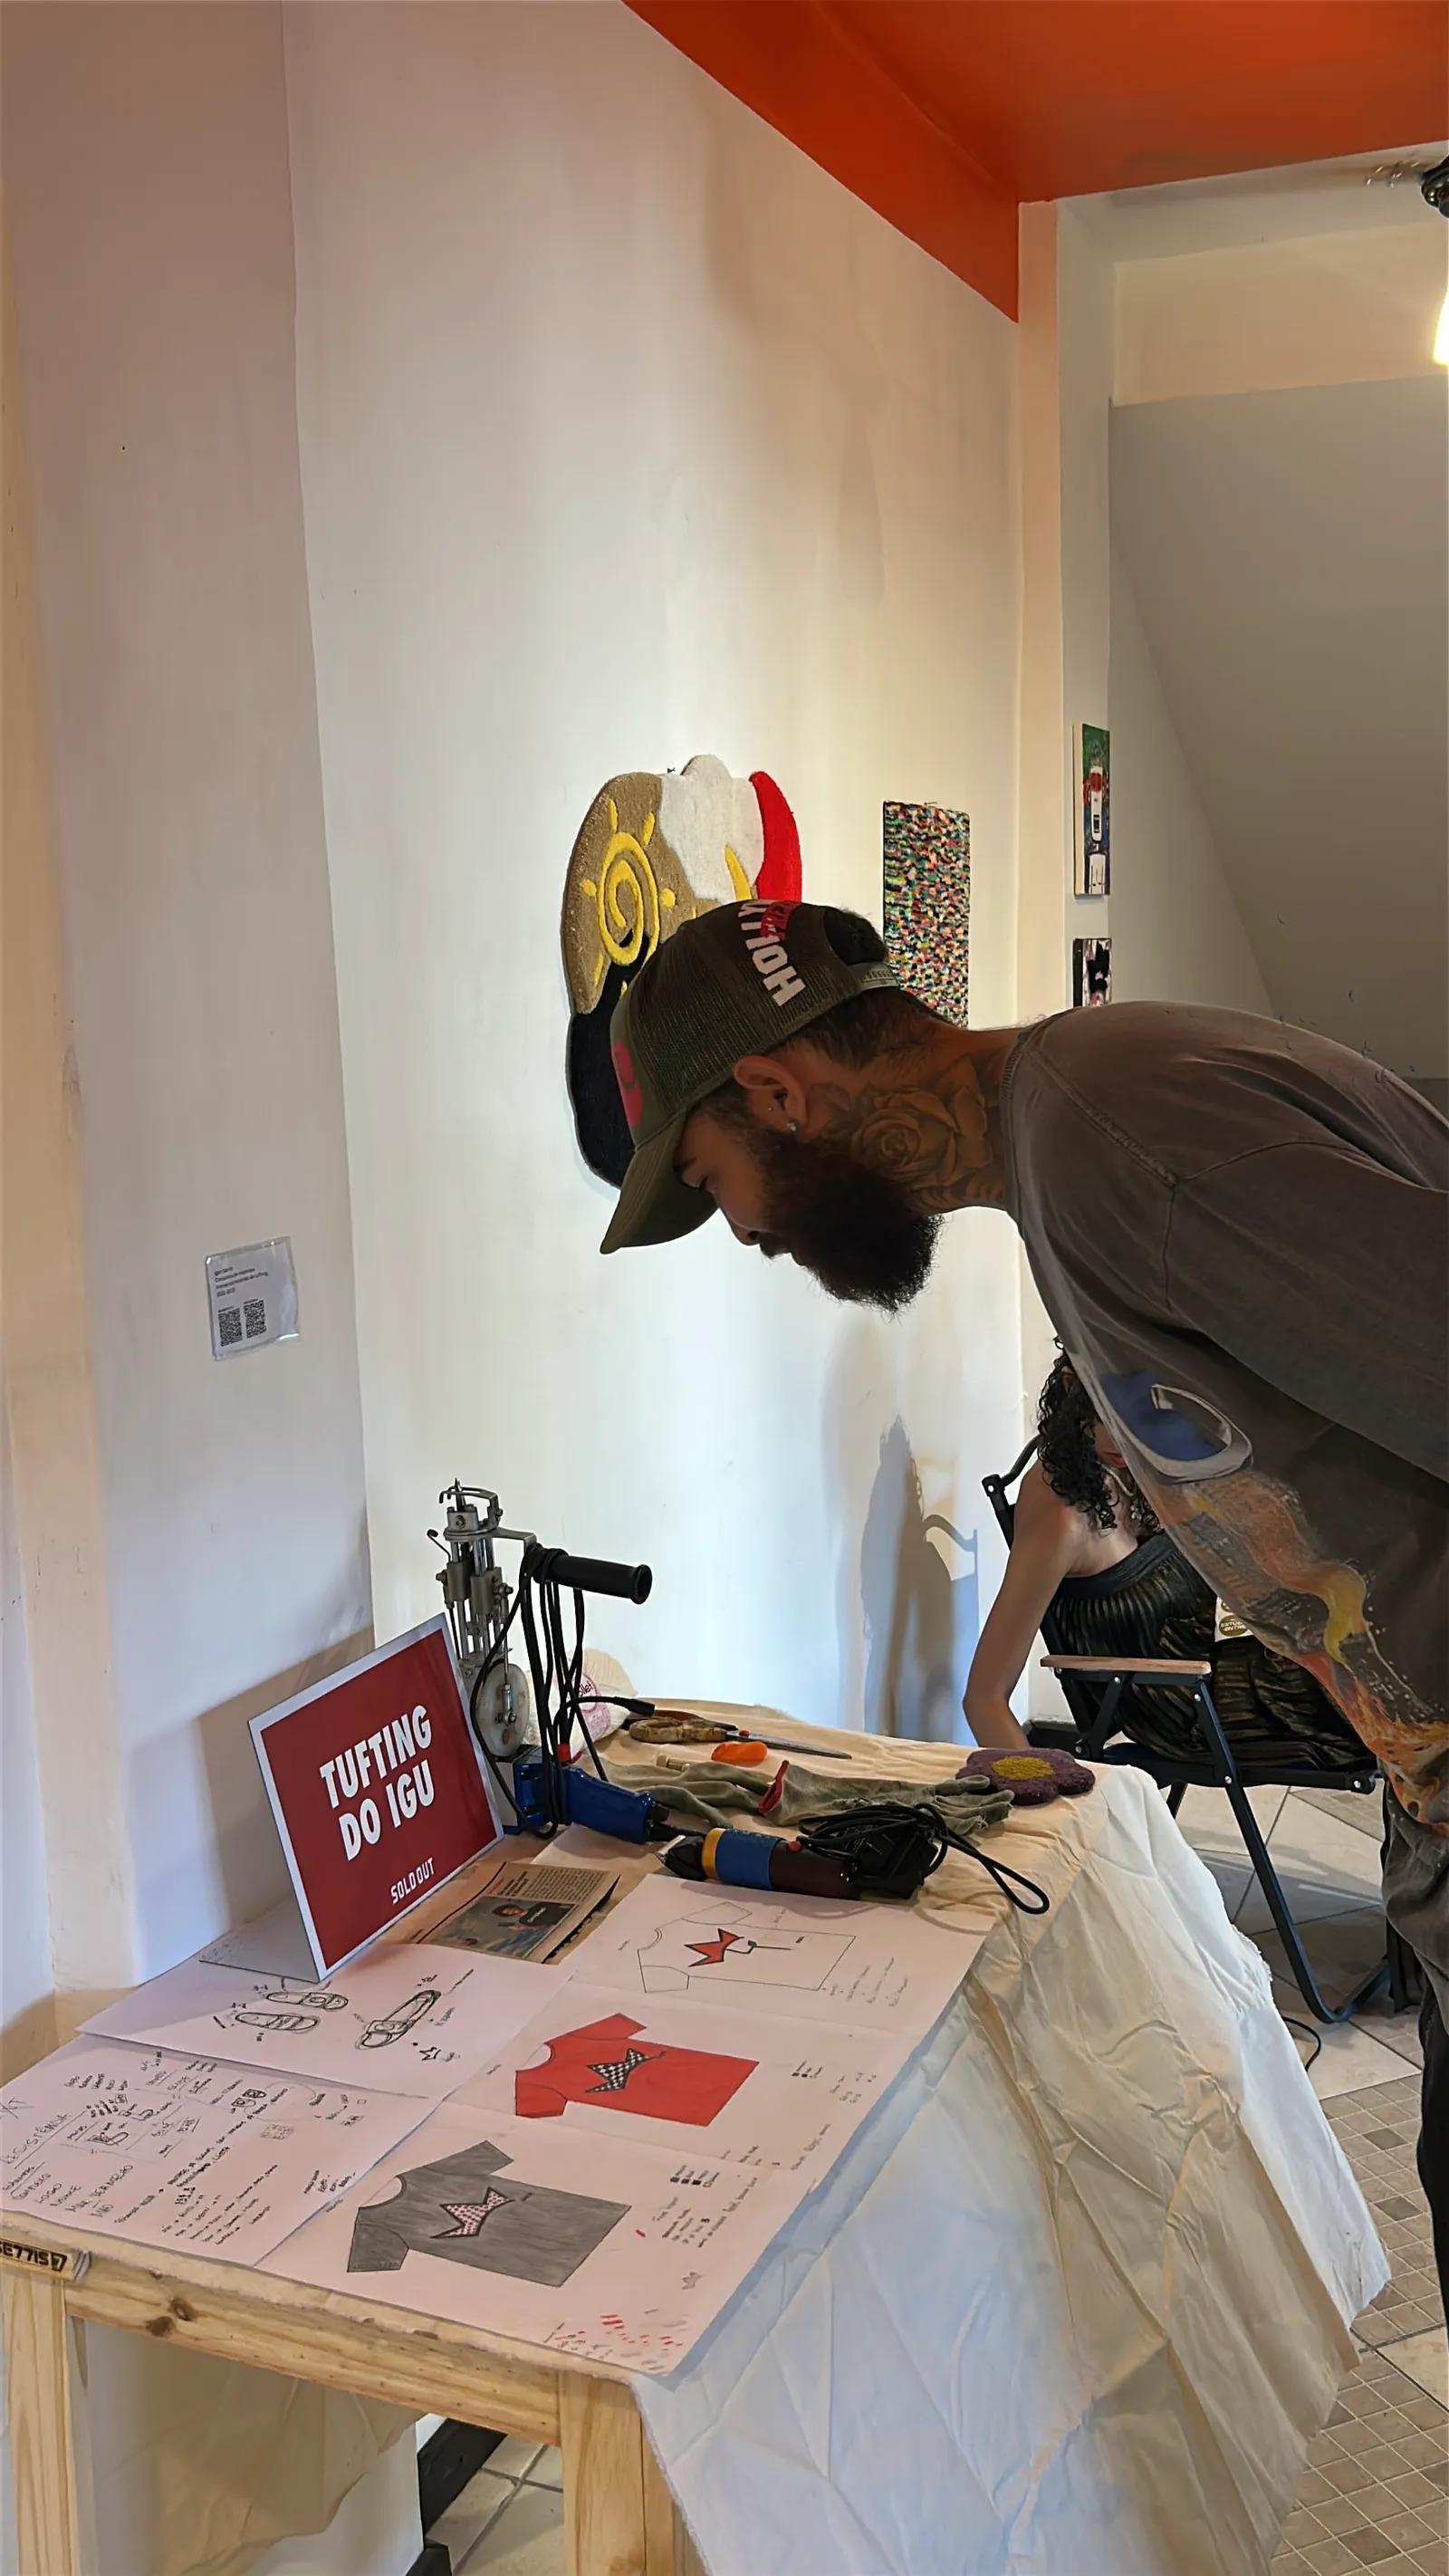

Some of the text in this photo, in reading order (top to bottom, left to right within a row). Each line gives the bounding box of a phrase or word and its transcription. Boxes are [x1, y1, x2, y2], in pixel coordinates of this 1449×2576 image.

[319, 1705, 432, 1809] TUFTING
[339, 1759, 435, 1861] DO IGU
[390, 1857, 435, 1905] SOLD OUT
